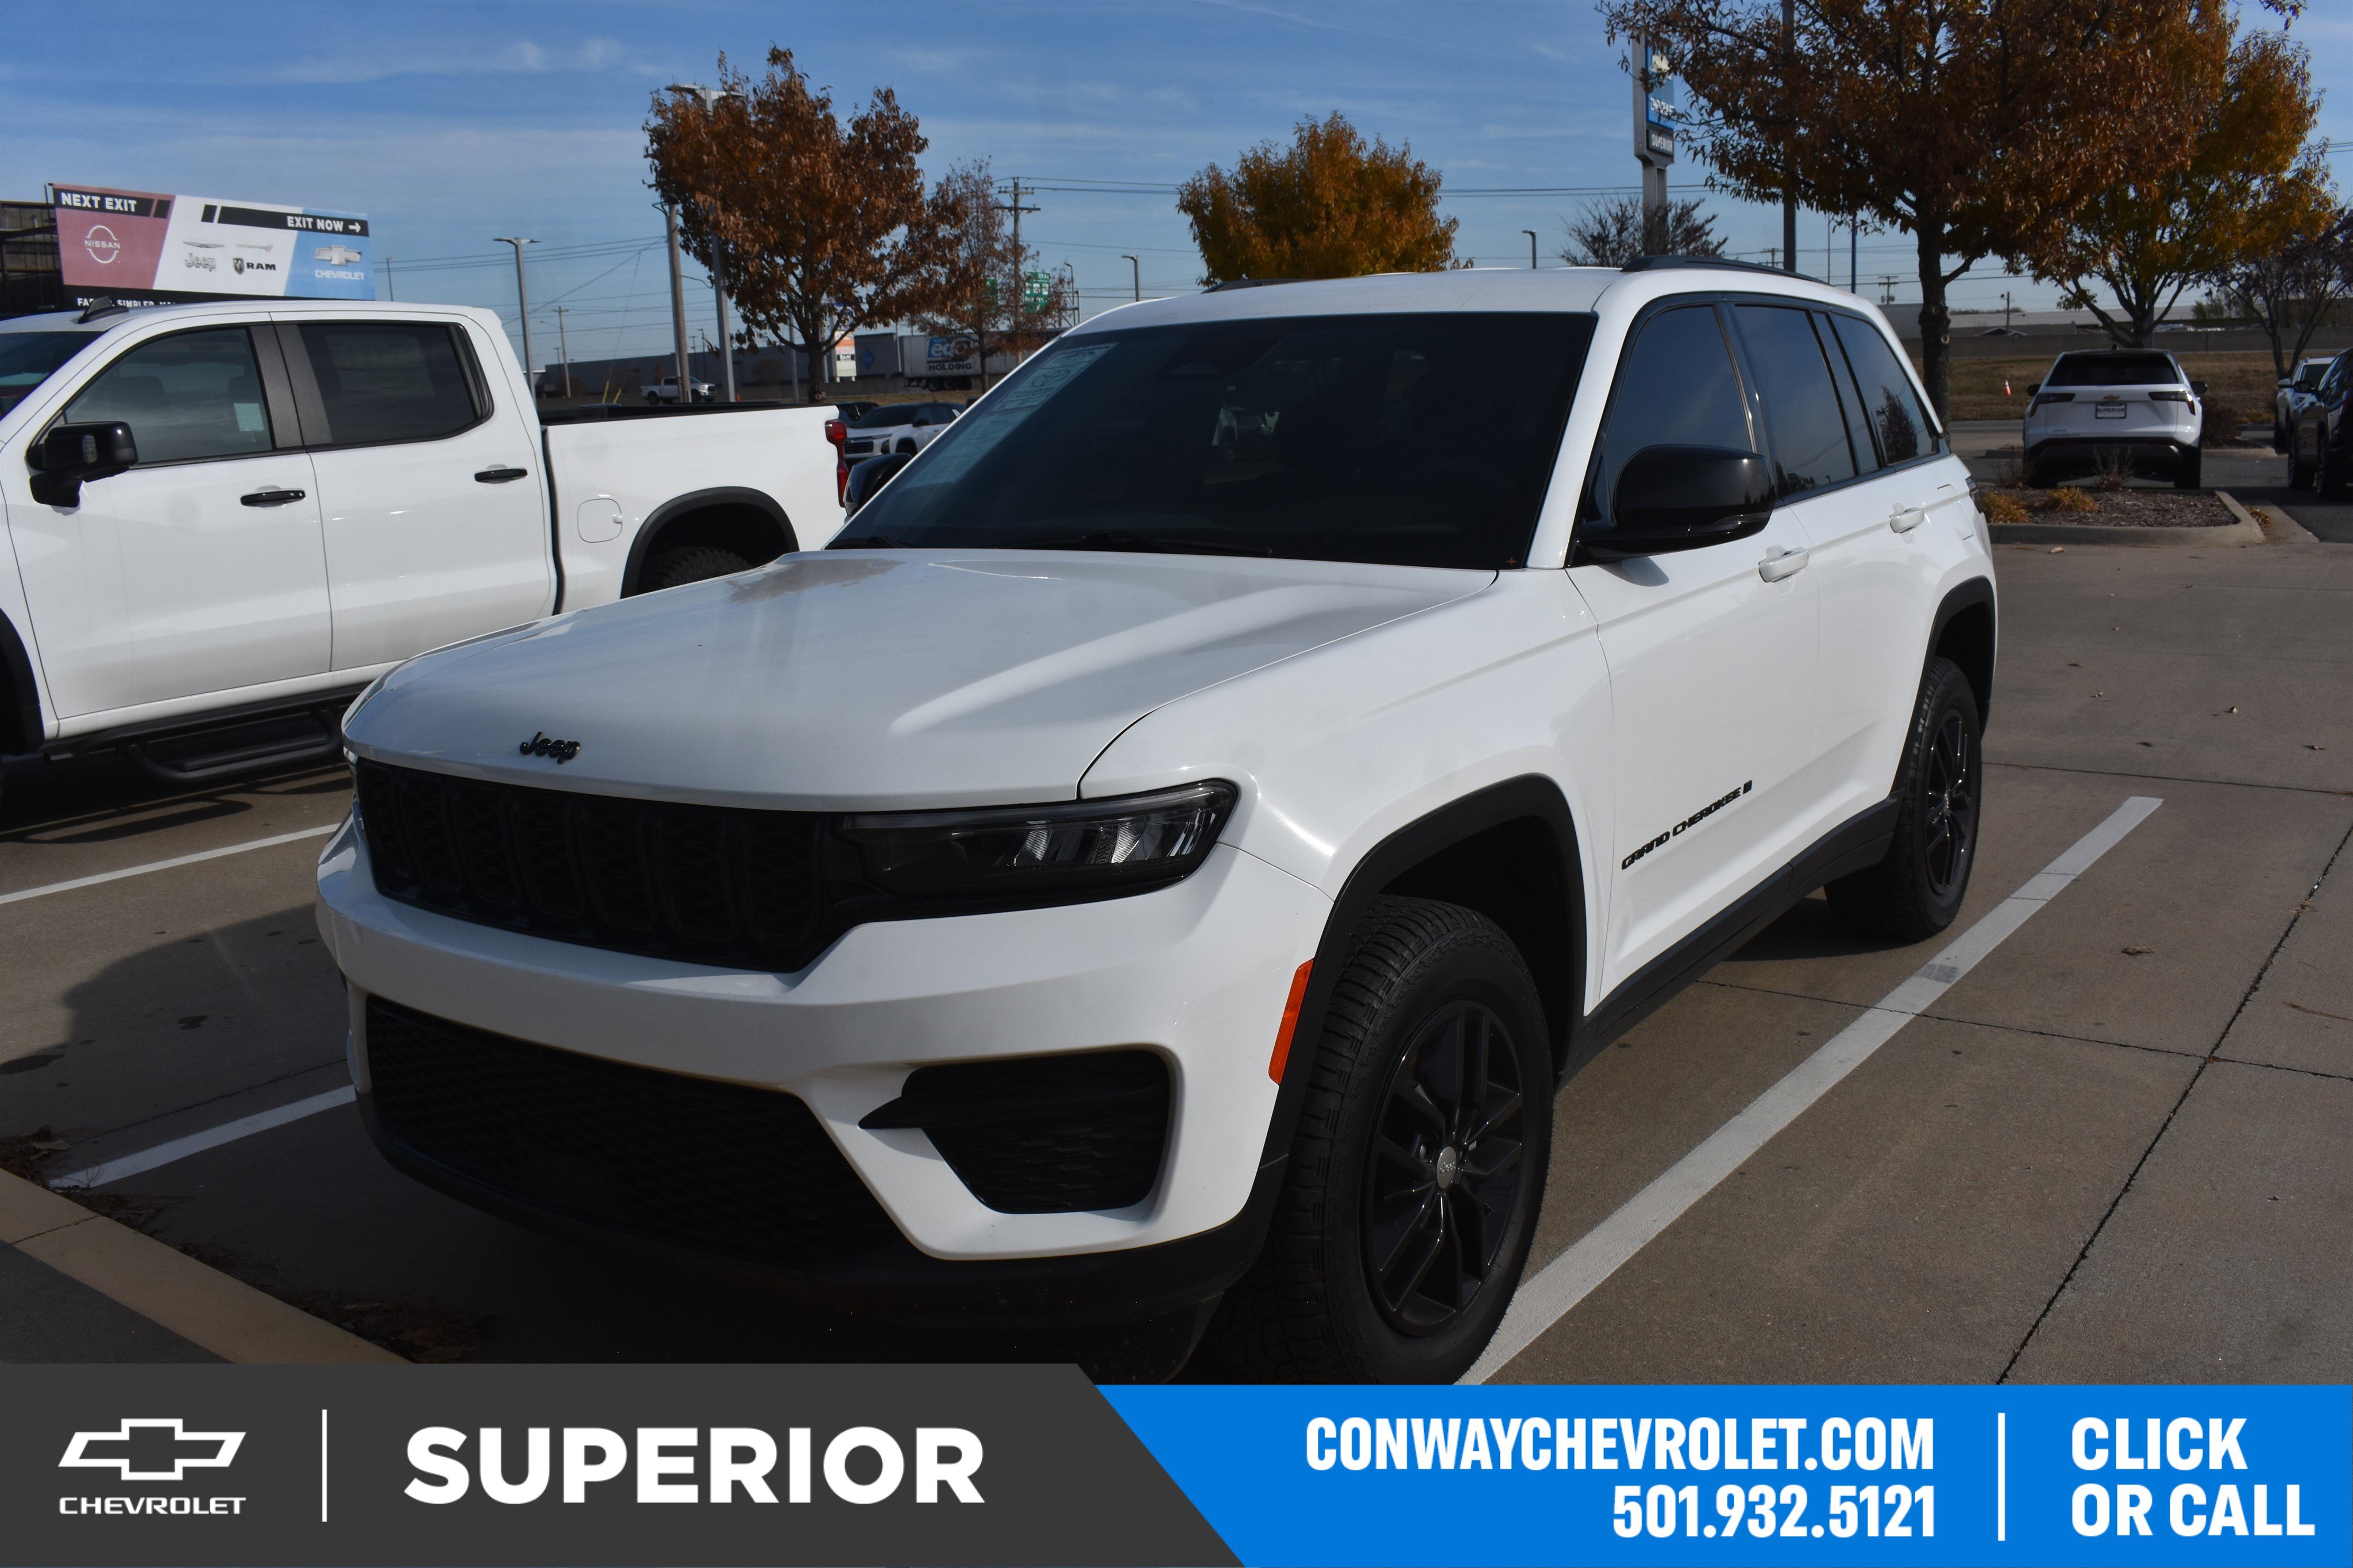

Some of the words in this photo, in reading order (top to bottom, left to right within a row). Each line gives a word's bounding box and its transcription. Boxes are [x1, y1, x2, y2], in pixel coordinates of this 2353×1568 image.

[1652, 133, 1673, 152] SUPERIOR
[61, 192, 101, 208] NEXT
[105, 197, 137, 212] EXIT
[287, 215, 313, 229] EXIT
[317, 219, 344, 231] NOW
[84, 240, 121, 249] NISSAN
[184, 253, 217, 272] Jeep
[246, 262, 276, 271] RAM
[315, 269, 365, 280] CHEVROLET
[928, 362, 972, 371] HOLDING
[519, 731, 581, 764] Jeep
[1621, 831, 1671, 871] GRAND
[1672, 786, 1742, 837] CHEROKEE
